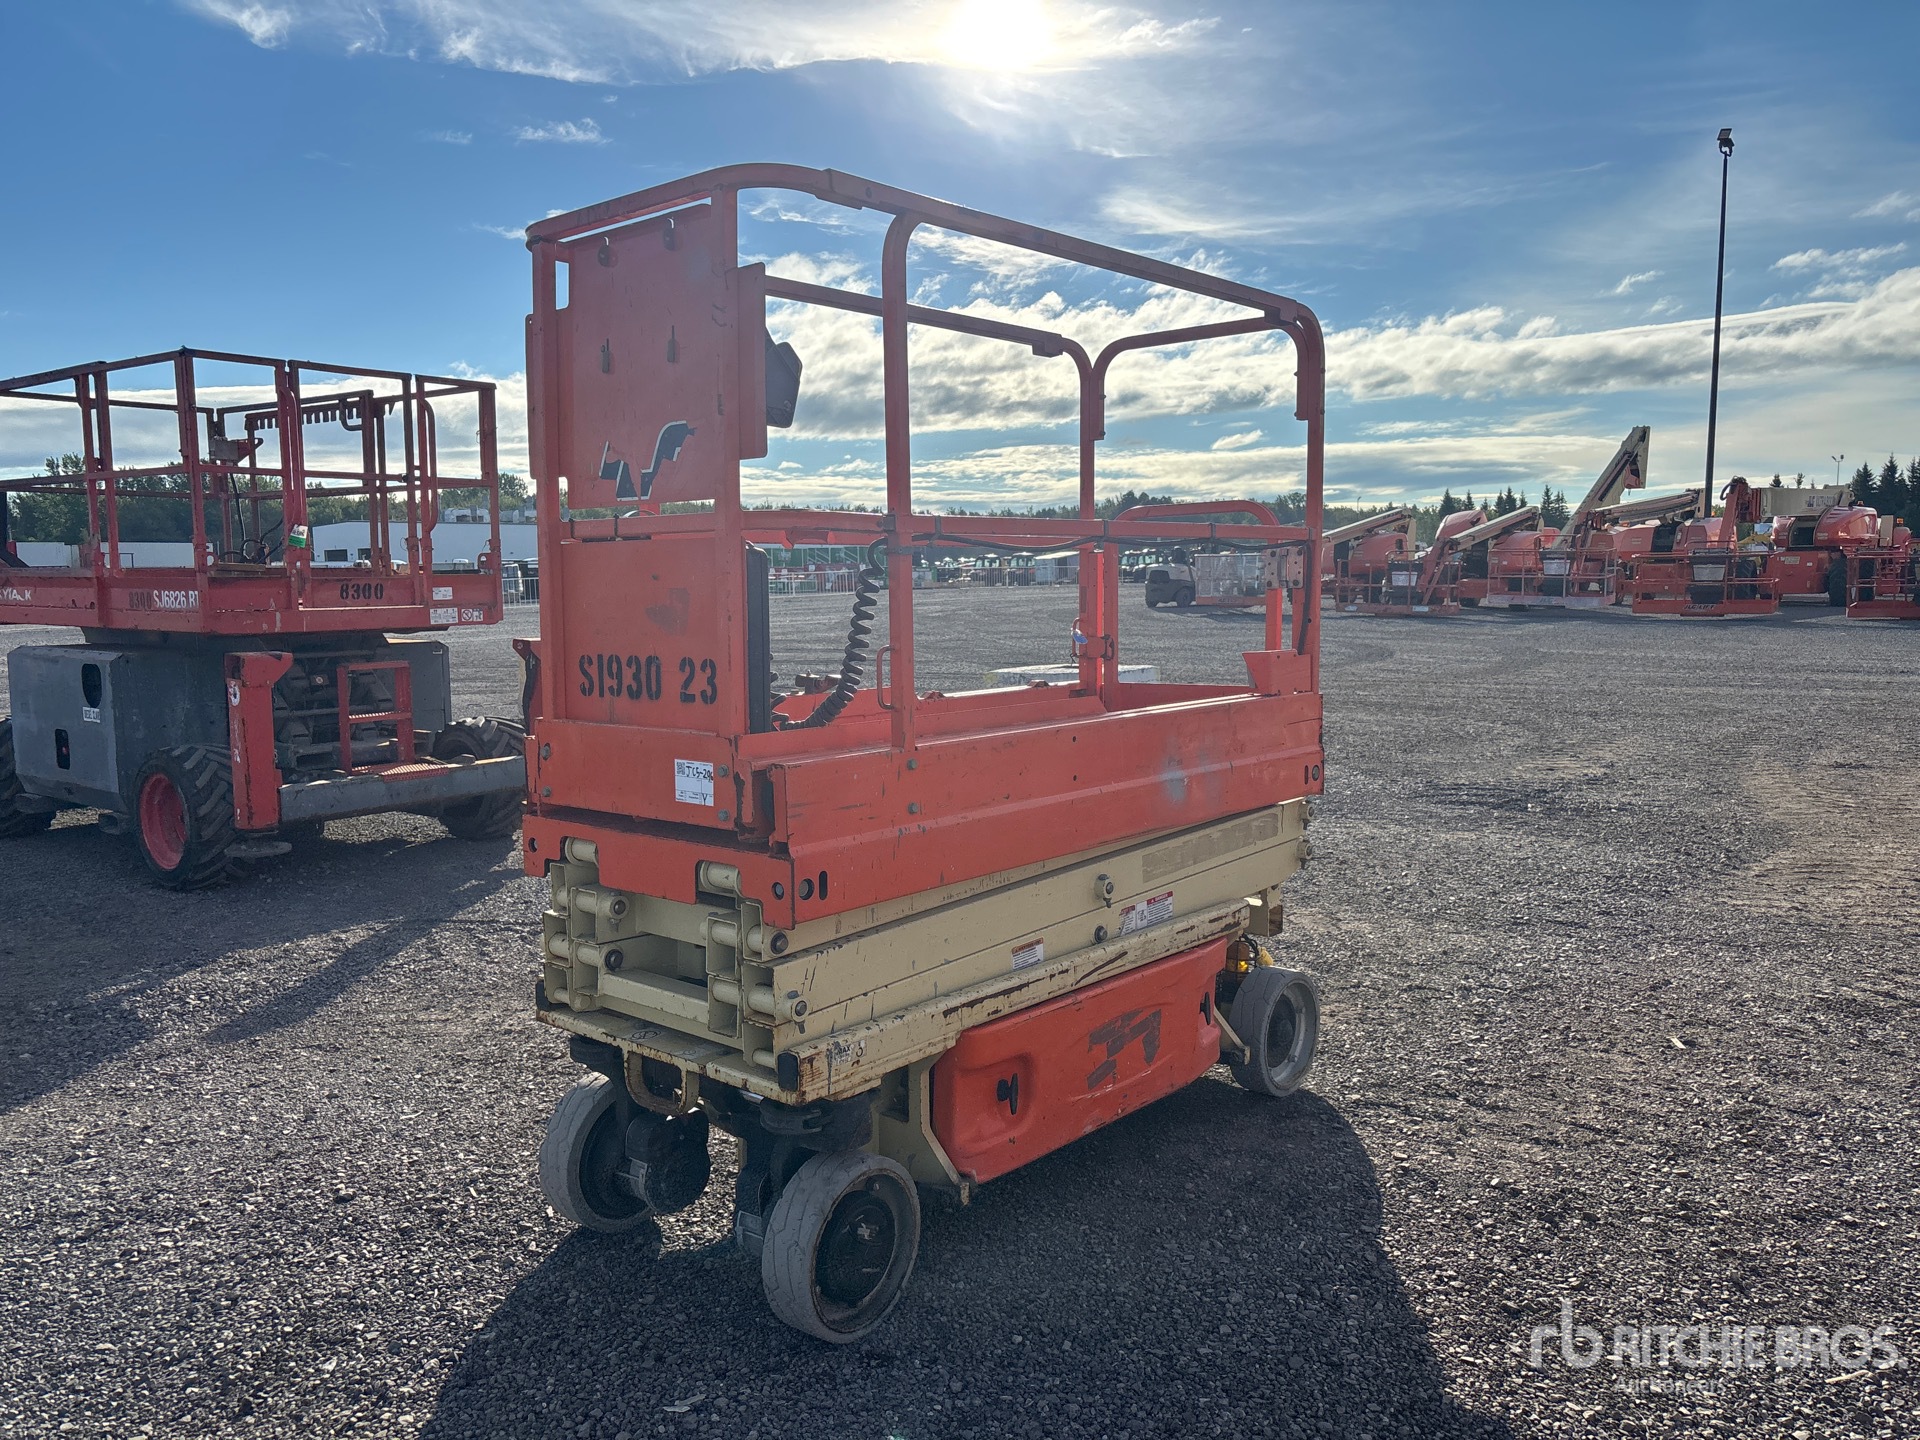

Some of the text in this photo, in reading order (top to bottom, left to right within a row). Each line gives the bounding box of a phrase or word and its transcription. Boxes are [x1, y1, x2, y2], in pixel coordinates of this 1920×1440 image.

[153, 589, 187, 608] SJ6826
[340, 583, 384, 600] 8300
[679, 656, 718, 705] 23
